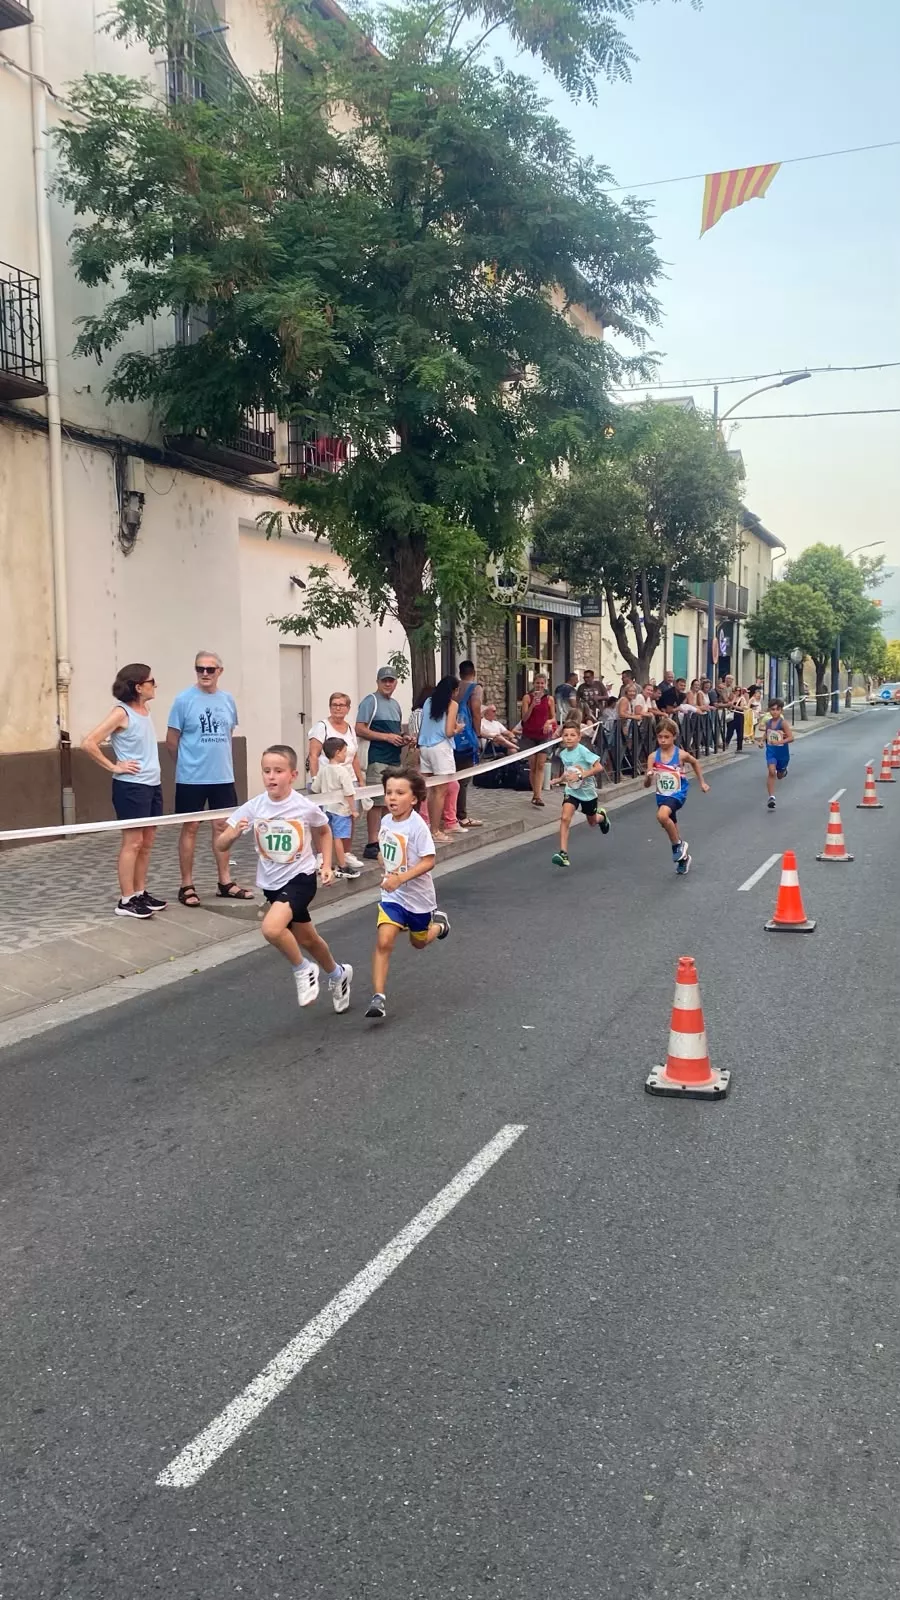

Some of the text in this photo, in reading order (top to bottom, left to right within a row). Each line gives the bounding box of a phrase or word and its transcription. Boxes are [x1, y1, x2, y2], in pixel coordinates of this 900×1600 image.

[659, 780, 675, 790] 152
[265, 834, 292, 852] 178
[383, 842, 396, 861] 177
